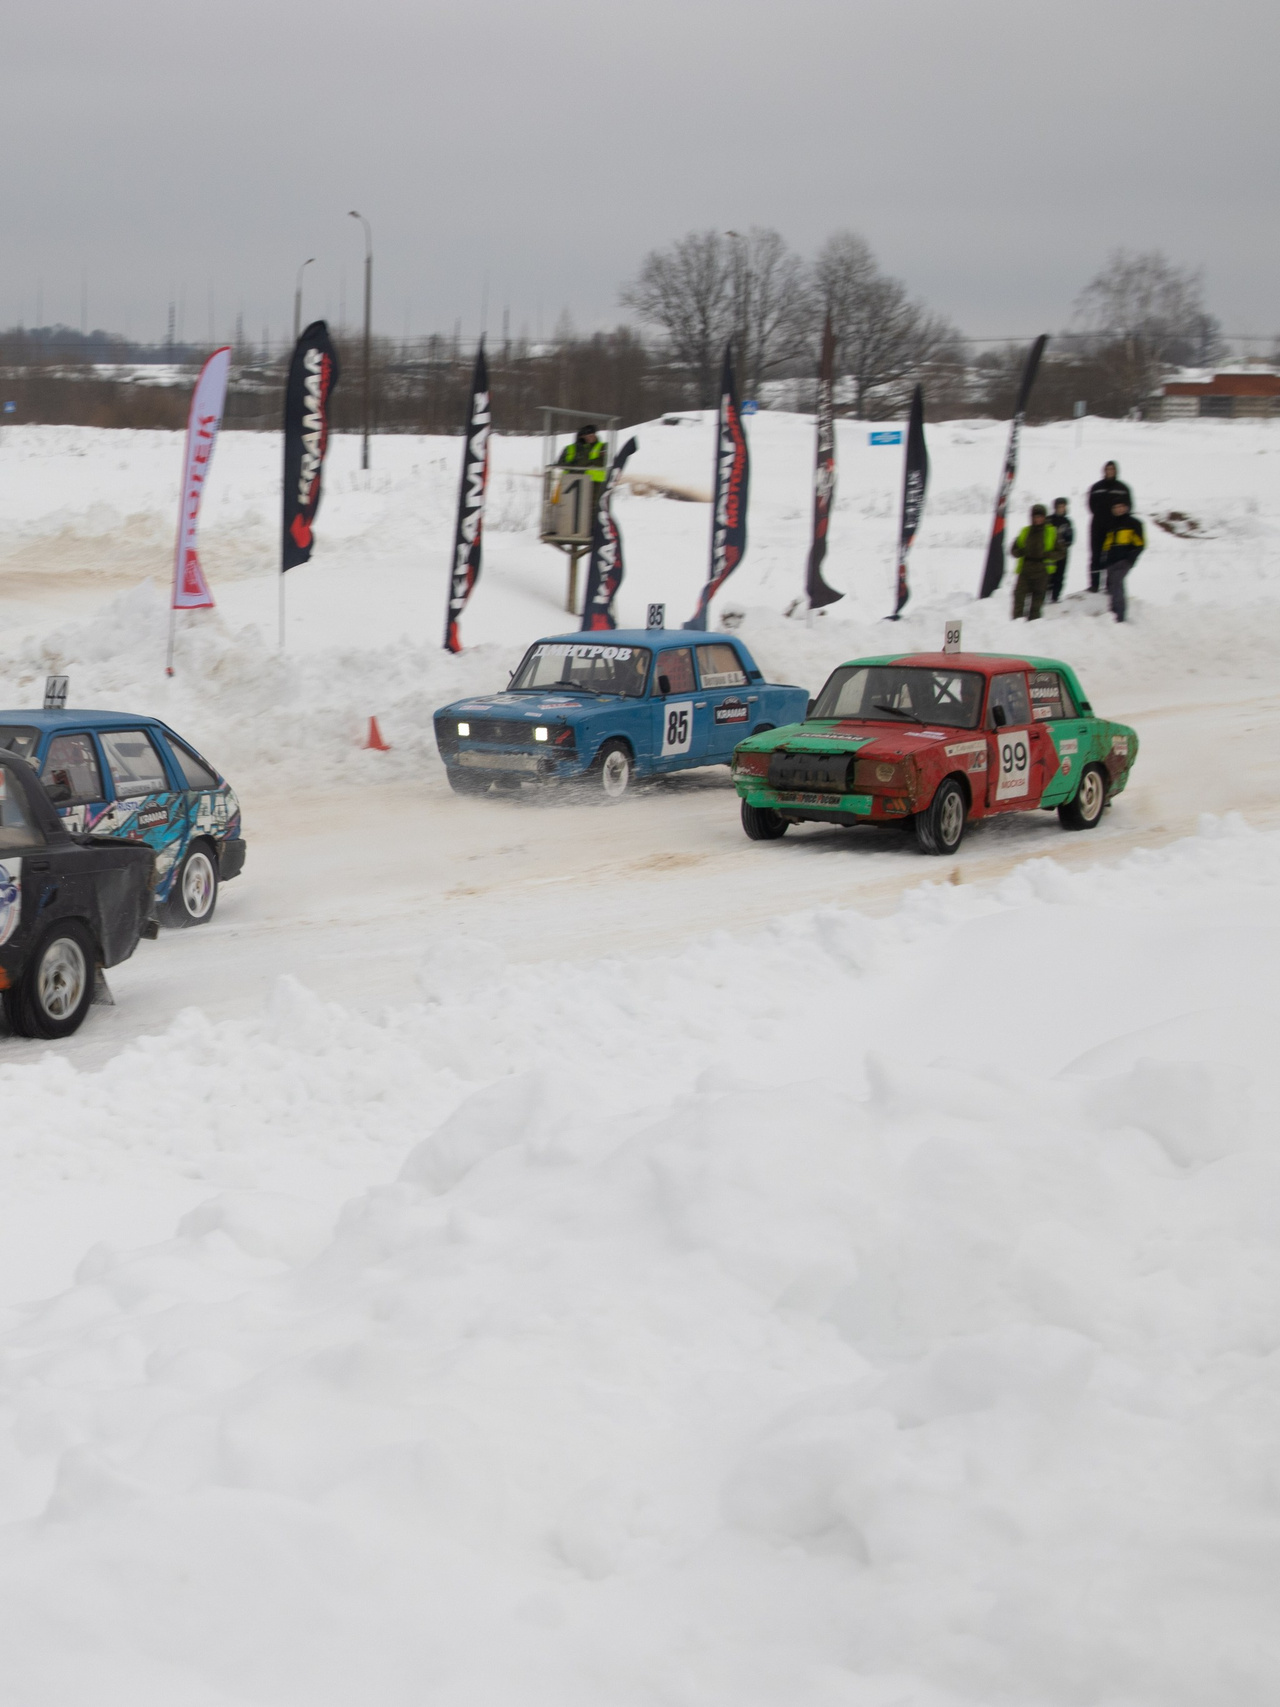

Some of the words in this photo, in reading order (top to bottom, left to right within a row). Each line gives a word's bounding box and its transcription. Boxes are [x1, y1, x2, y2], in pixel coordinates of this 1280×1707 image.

[297, 348, 324, 505] KRAMAR
[450, 390, 489, 609] KRAMAR
[562, 479, 582, 534] 1
[649, 605, 664, 626] 85
[946, 629, 960, 644] 99
[531, 644, 632, 661] ДМИТРОВ
[47, 678, 68, 700] 44
[1030, 687, 1059, 699] KRAMAR
[717, 708, 747, 719] KRAMAR
[667, 711, 688, 745] 85
[1003, 742, 1027, 773] 99
[140, 811, 168, 824] KRAMAR
